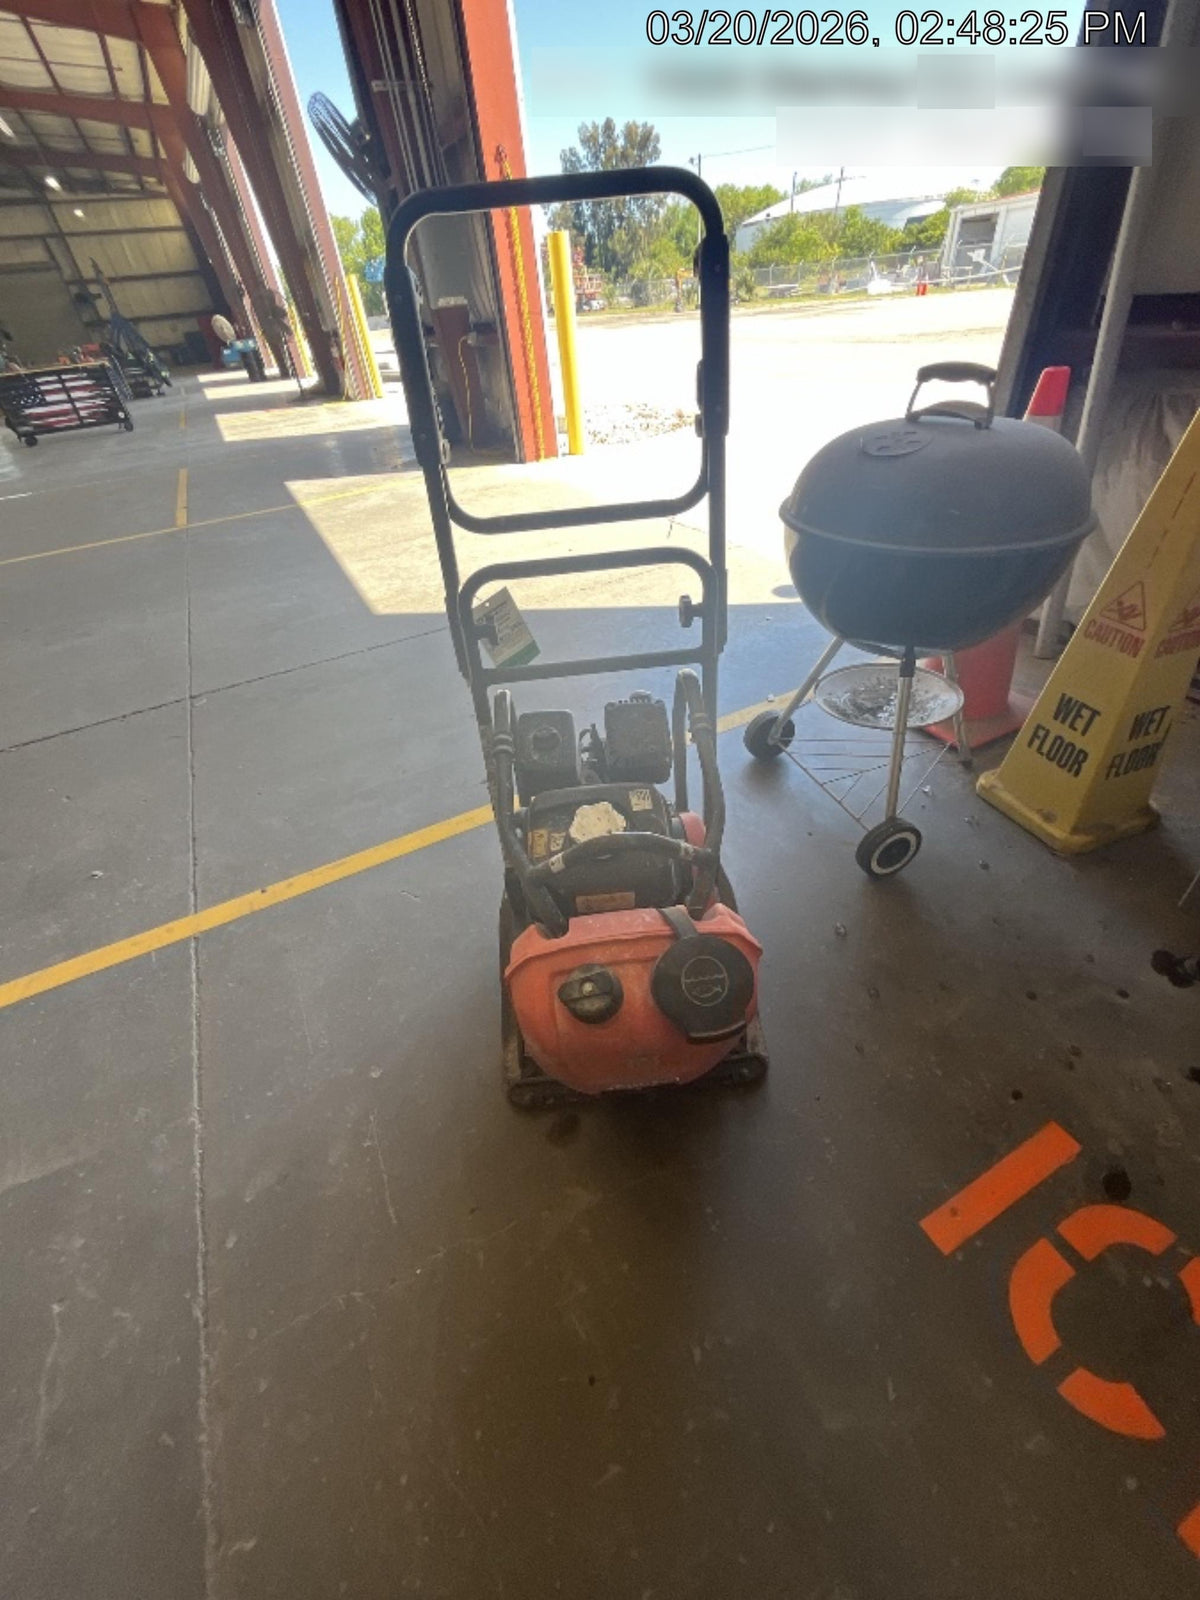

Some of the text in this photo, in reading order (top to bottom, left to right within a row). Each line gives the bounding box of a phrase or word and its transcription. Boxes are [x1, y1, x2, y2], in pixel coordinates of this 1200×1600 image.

[1083, 618, 1146, 659] CAUTION
[1052, 692, 1102, 738] WET
[1127, 704, 1172, 743] WET
[1026, 722, 1089, 779] FLOOR
